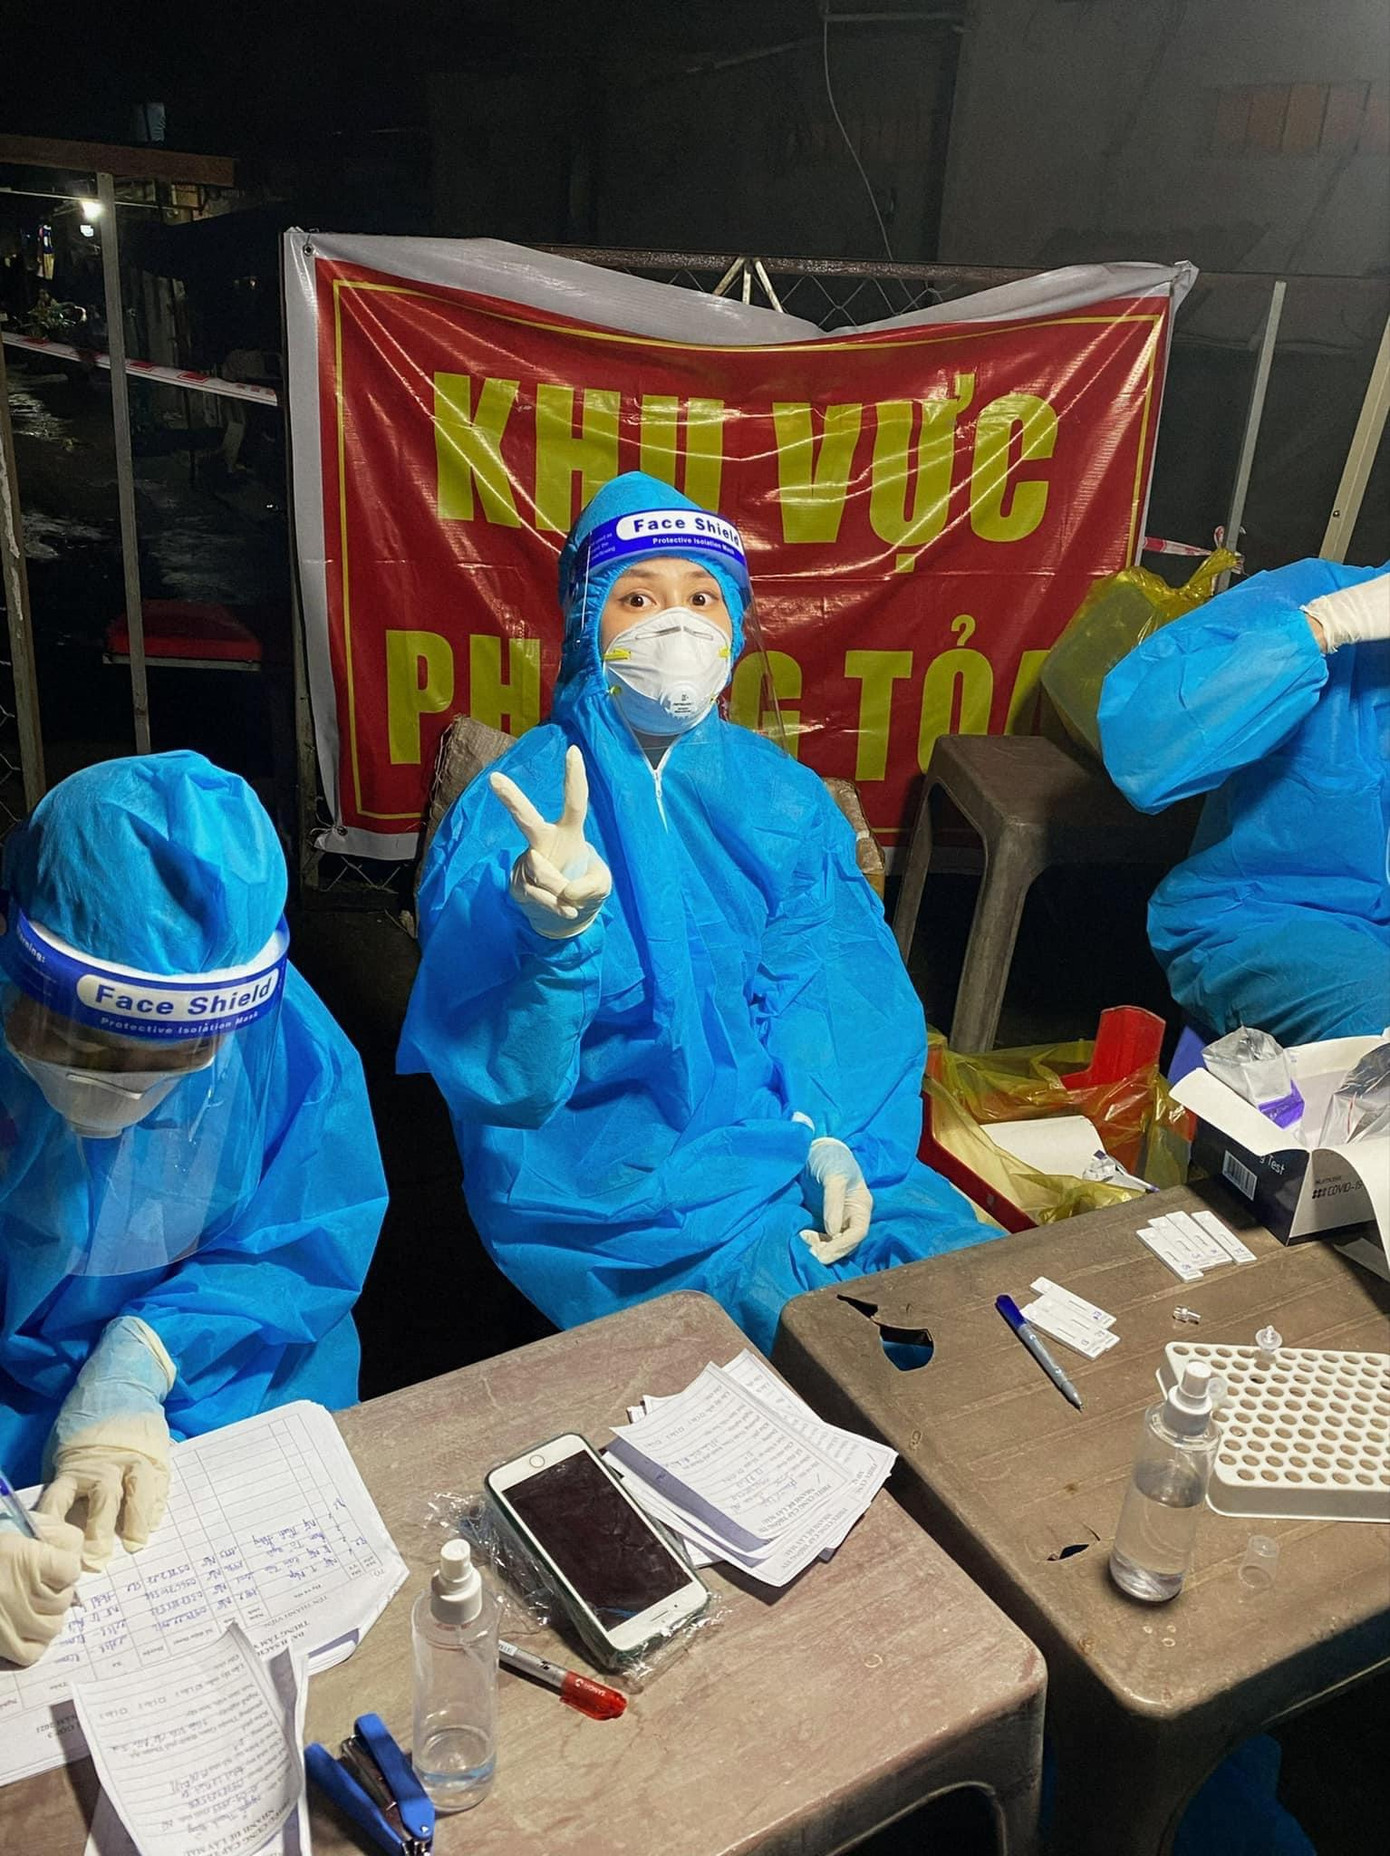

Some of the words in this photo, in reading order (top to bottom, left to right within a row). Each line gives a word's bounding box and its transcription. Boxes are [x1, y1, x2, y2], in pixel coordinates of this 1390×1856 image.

[772, 373, 1059, 573] VỰC
[633, 519, 686, 533] Face
[695, 517, 740, 547] Shield
[652, 536, 692, 545] Protective
[386, 629, 802, 764] PHG
[95, 984, 174, 1015] Face
[187, 977, 273, 1016] Shield
[100, 1016, 173, 1035] Protective
[178, 1021, 232, 1034] Isolation
[1267, 1154, 1286, 1176] Test
